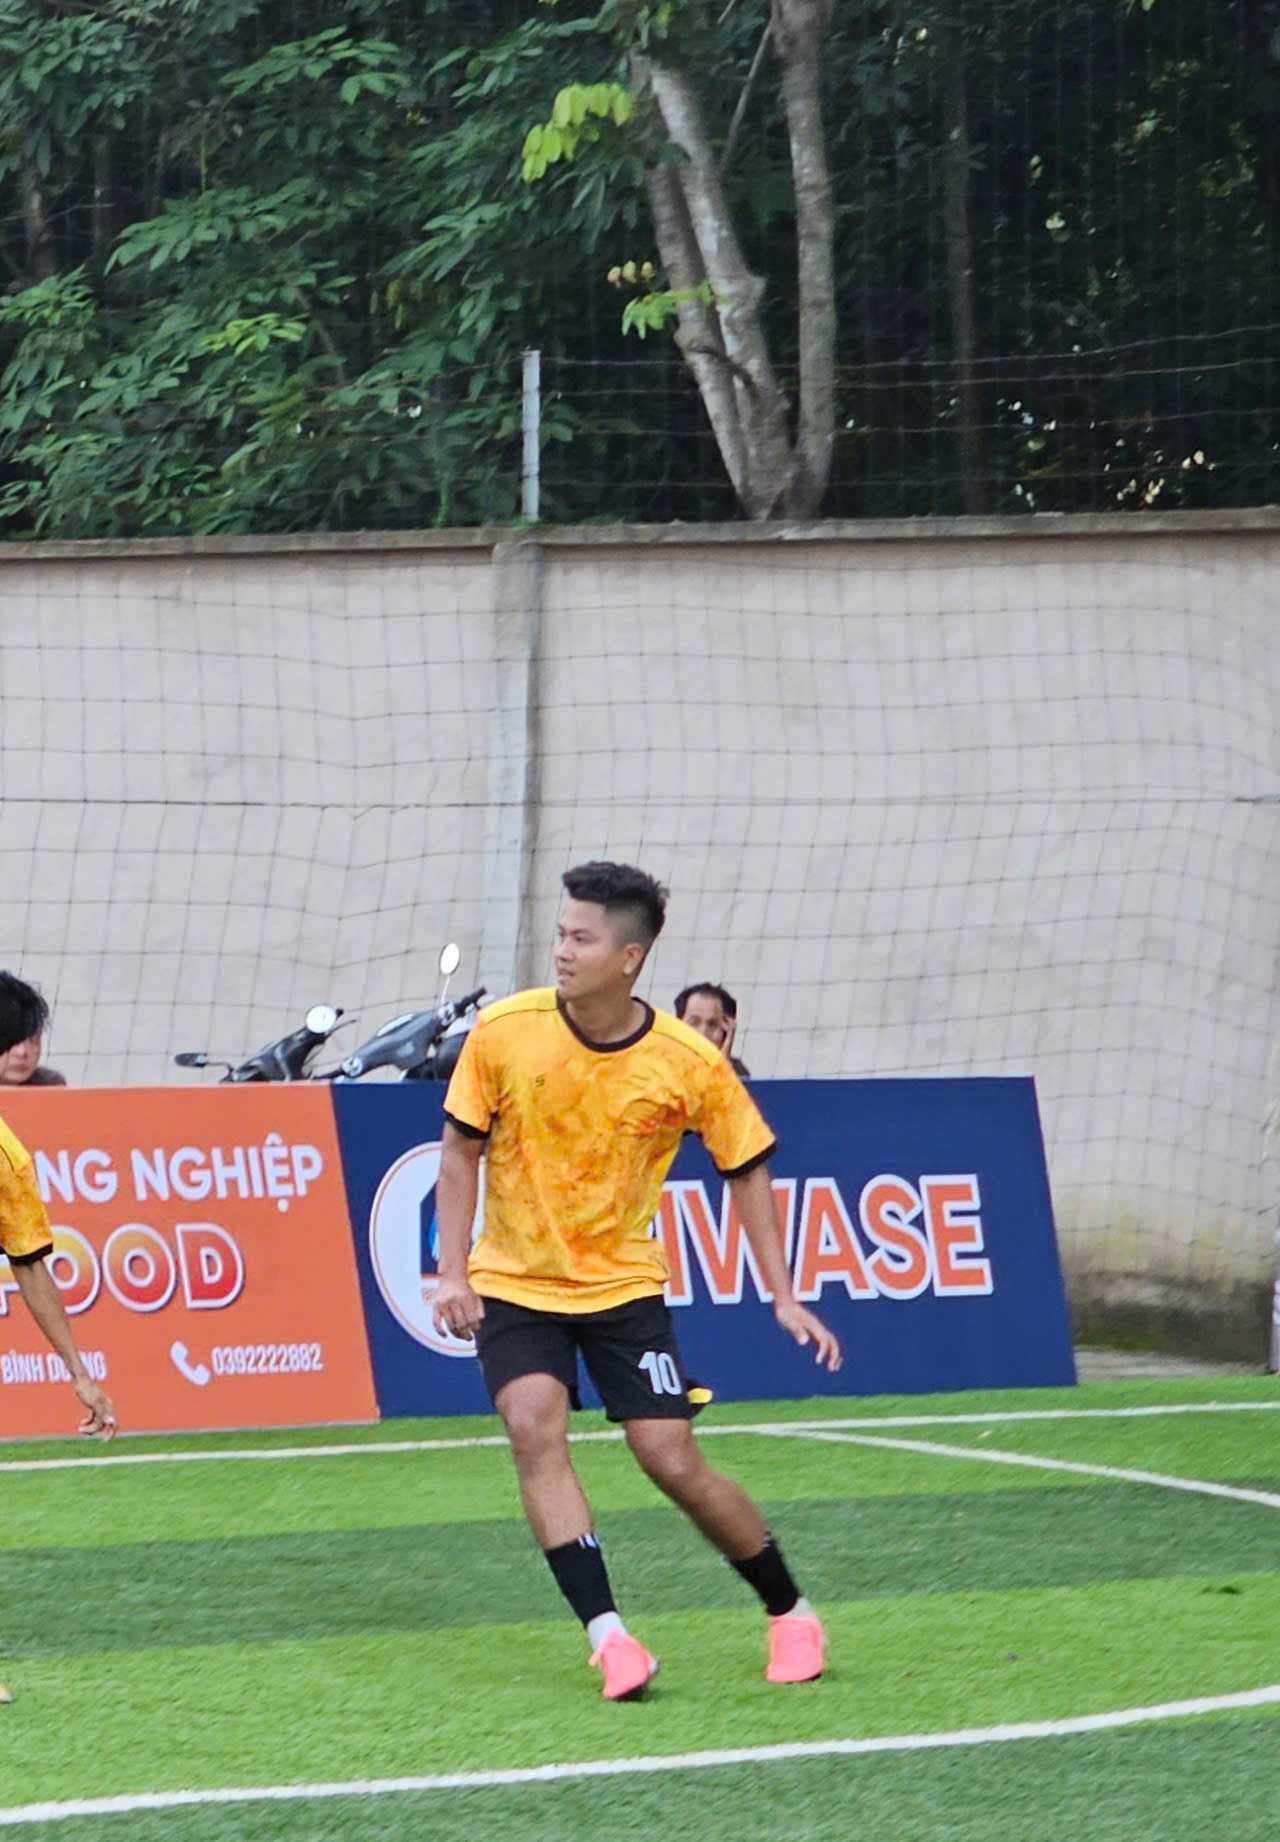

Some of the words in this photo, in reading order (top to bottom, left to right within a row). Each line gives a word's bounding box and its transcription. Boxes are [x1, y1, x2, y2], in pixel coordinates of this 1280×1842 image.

[34, 1149, 118, 1204] NG
[131, 1133, 322, 1212] NGHIỆP
[646, 1174, 993, 1306] IWASE
[0, 1348, 45, 1385] BÌNH
[211, 1342, 324, 1376] 0392222882
[638, 1350, 683, 1396] 10
